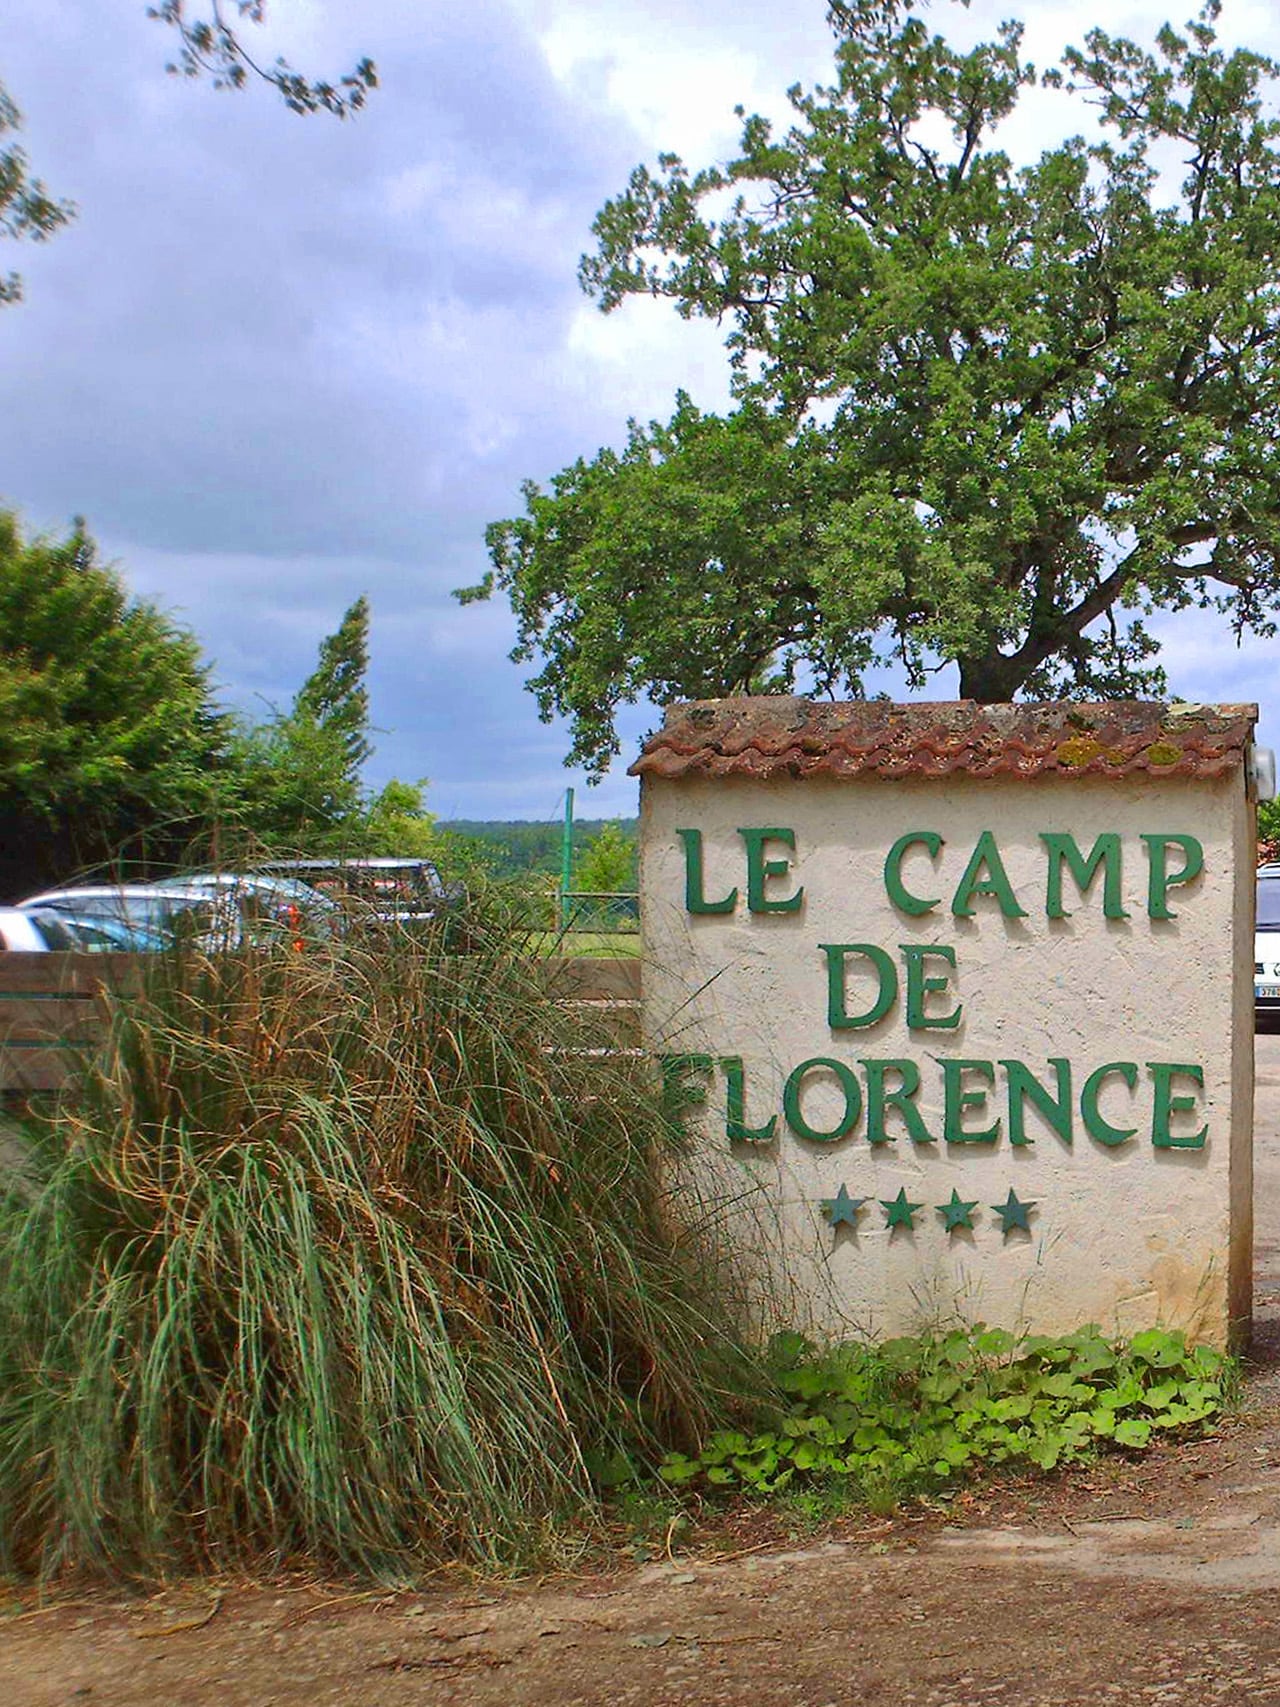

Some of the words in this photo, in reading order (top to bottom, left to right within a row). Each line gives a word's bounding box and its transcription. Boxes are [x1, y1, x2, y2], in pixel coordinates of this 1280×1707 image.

[675, 827, 804, 914] LE
[884, 830, 1205, 920] CAMP
[818, 942, 964, 1030] DE
[660, 1053, 1210, 1149] FLORENCE
